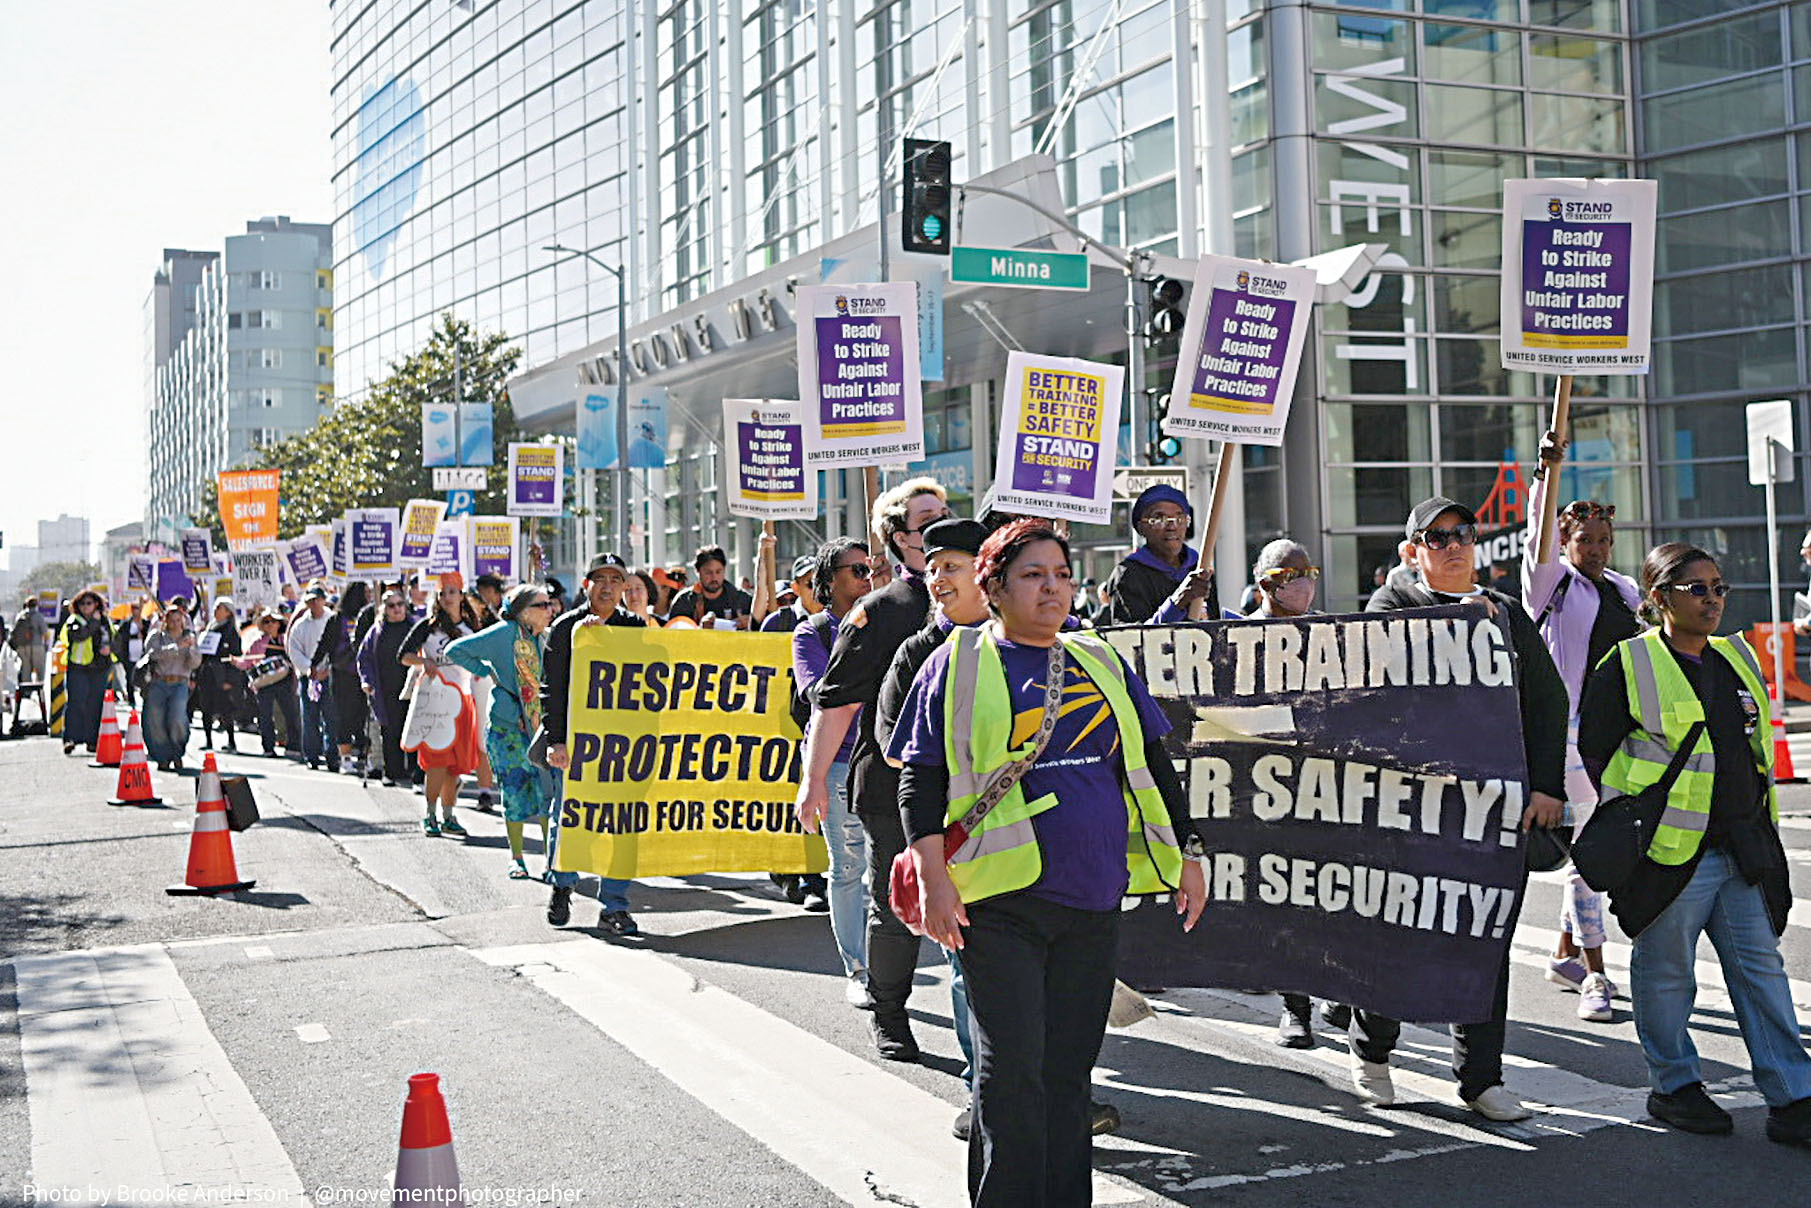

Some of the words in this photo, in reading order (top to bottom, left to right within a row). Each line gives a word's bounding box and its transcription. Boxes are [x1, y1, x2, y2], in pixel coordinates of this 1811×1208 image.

[1566, 202, 1612, 213] STAND
[1326, 57, 1417, 389] WEST
[1552, 229, 1603, 247] Ready
[1541, 250, 1559, 266] to
[1562, 250, 1612, 267] Strike
[991, 257, 1050, 279] Minna
[1252, 276, 1287, 290] STAND
[1544, 271, 1607, 289] Against
[851, 298, 886, 308] STAND
[1525, 291, 1573, 307] Unfair
[1578, 293, 1624, 309] Labor
[1235, 300, 1276, 321] Ready
[1223, 318, 1237, 333] to
[1240, 321, 1279, 340] Strike
[1534, 312, 1612, 330] Practices
[842, 324, 882, 340] Ready
[834, 343, 848, 359] to
[852, 343, 890, 358] Strike
[1221, 338, 1272, 359] Against
[1506, 352, 1536, 362] UNITED
[1538, 354, 1573, 364] SERVICE
[1577, 355, 1618, 364] WORKERS
[1621, 355, 1645, 364] WEST
[838, 362, 888, 380] Against
[1201, 355, 1242, 375] Unfair
[1244, 361, 1280, 380] Labor
[822, 383, 864, 399] Unfair
[867, 381, 901, 396] Labor
[1029, 372, 1098, 394] BETTER
[1204, 375, 1268, 398] Practices
[1029, 388, 1098, 406] TRAINING
[832, 402, 894, 418] Practices
[1039, 402, 1096, 420] BETTER
[755, 428, 786, 440] Ready
[1026, 415, 1095, 438] SAFETY
[1170, 417, 1197, 427] UNITED
[1199, 420, 1230, 432] SERVICE
[1232, 424, 1262, 434] WORKERS
[1264, 427, 1281, 436] WEST
[749, 441, 759, 450] to
[762, 441, 792, 452] Strike
[808, 451, 835, 460] UNITED
[838, 449, 869, 458] SERVICE
[872, 445, 900, 455] WORKERS
[902, 443, 920, 452] WEST
[1023, 436, 1093, 459] STAND
[752, 453, 789, 465] Against
[1036, 454, 1093, 471] SECURITY
[742, 464, 769, 476] Unfair
[772, 466, 800, 477] Labor
[747, 478, 795, 489] Practices
[1127, 478, 1151, 490] ONE
[233, 502, 266, 519] SIGN
[452, 492, 470, 514] P
[1024, 497, 1053, 507] SERVICE
[1089, 506, 1107, 515] WEST
[1473, 528, 1528, 571] NCIS
[1106, 628, 1214, 697] TER
[1227, 619, 1513, 695] TRAINING
[586, 661, 776, 714] RESPECT
[124, 768, 149, 789] CMC
[1252, 755, 1524, 848] SAFETY!
[562, 798, 649, 835] STAND
[656, 801, 704, 832] FOR
[1259, 853, 1516, 939] SECURITY!
